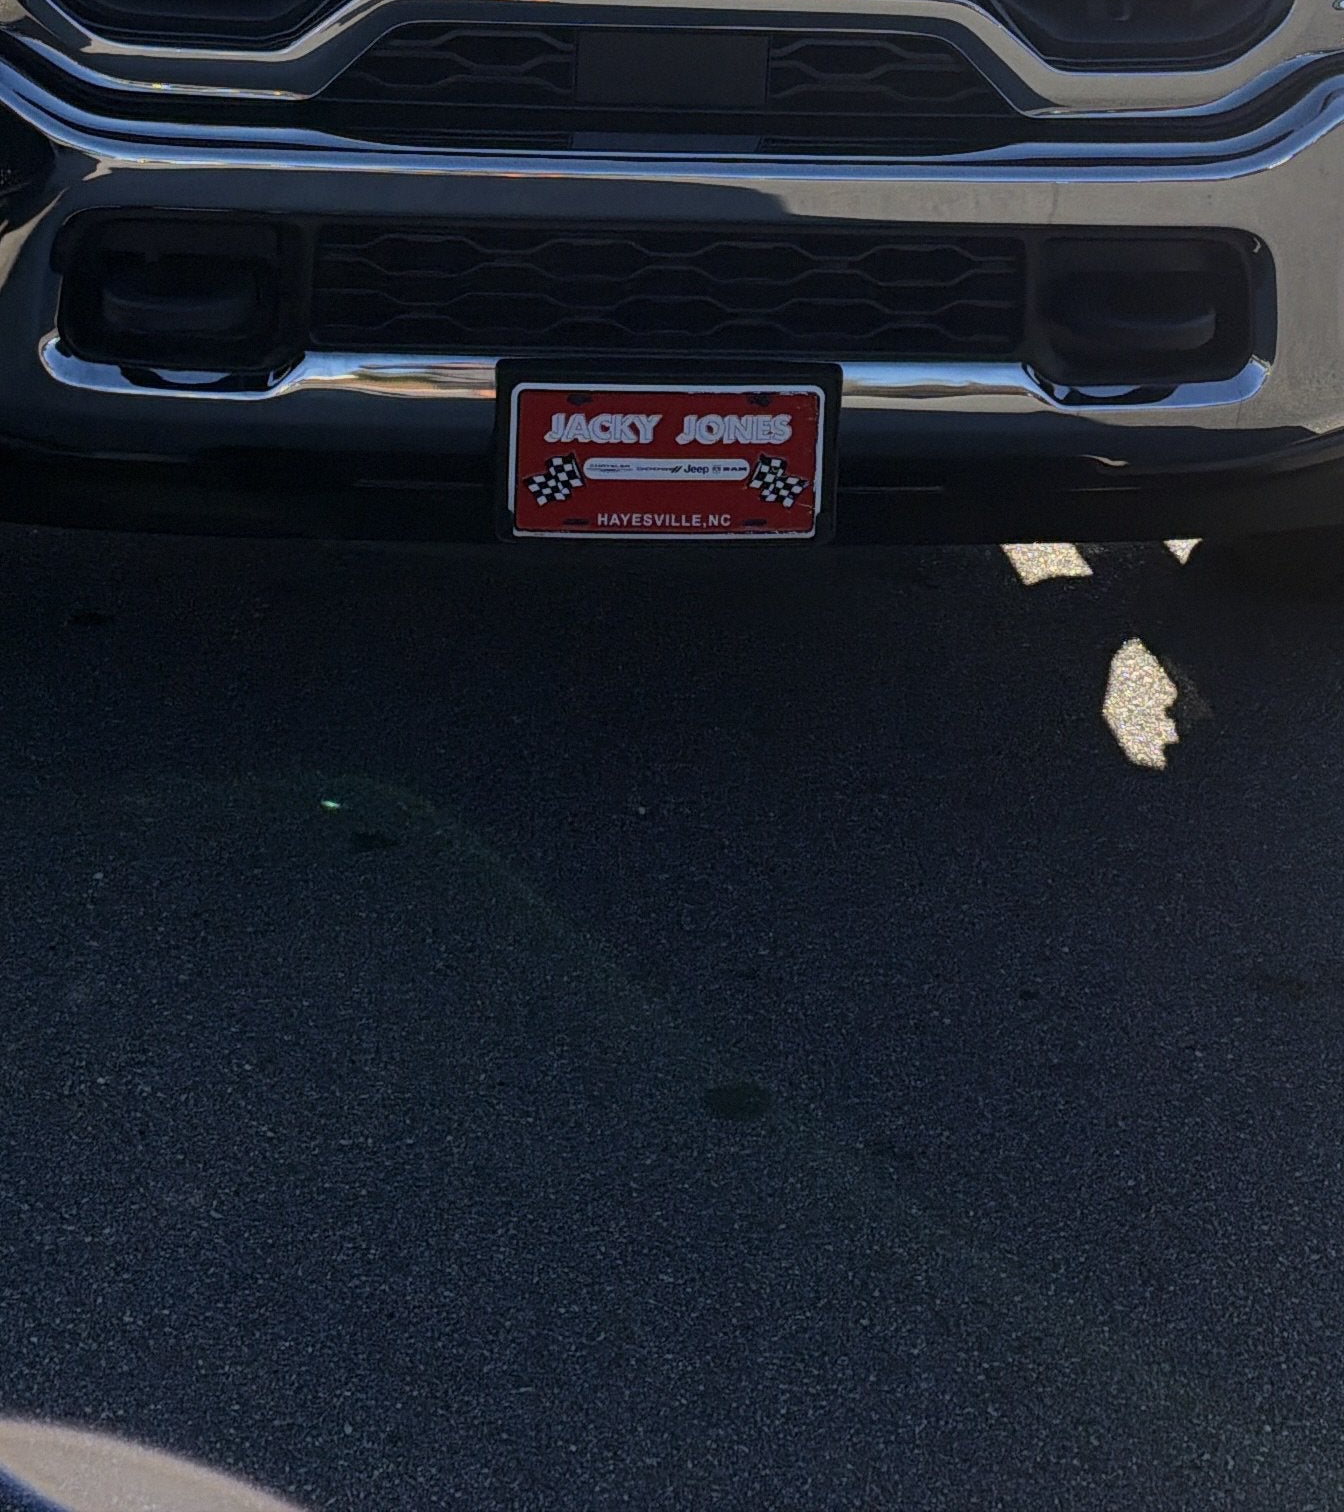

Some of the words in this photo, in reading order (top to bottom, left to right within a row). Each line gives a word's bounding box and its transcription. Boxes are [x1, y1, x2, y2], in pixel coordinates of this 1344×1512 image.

[544, 413, 663, 444] JACKY
[676, 413, 793, 445] JONES
[684, 464, 710, 475] Jeep
